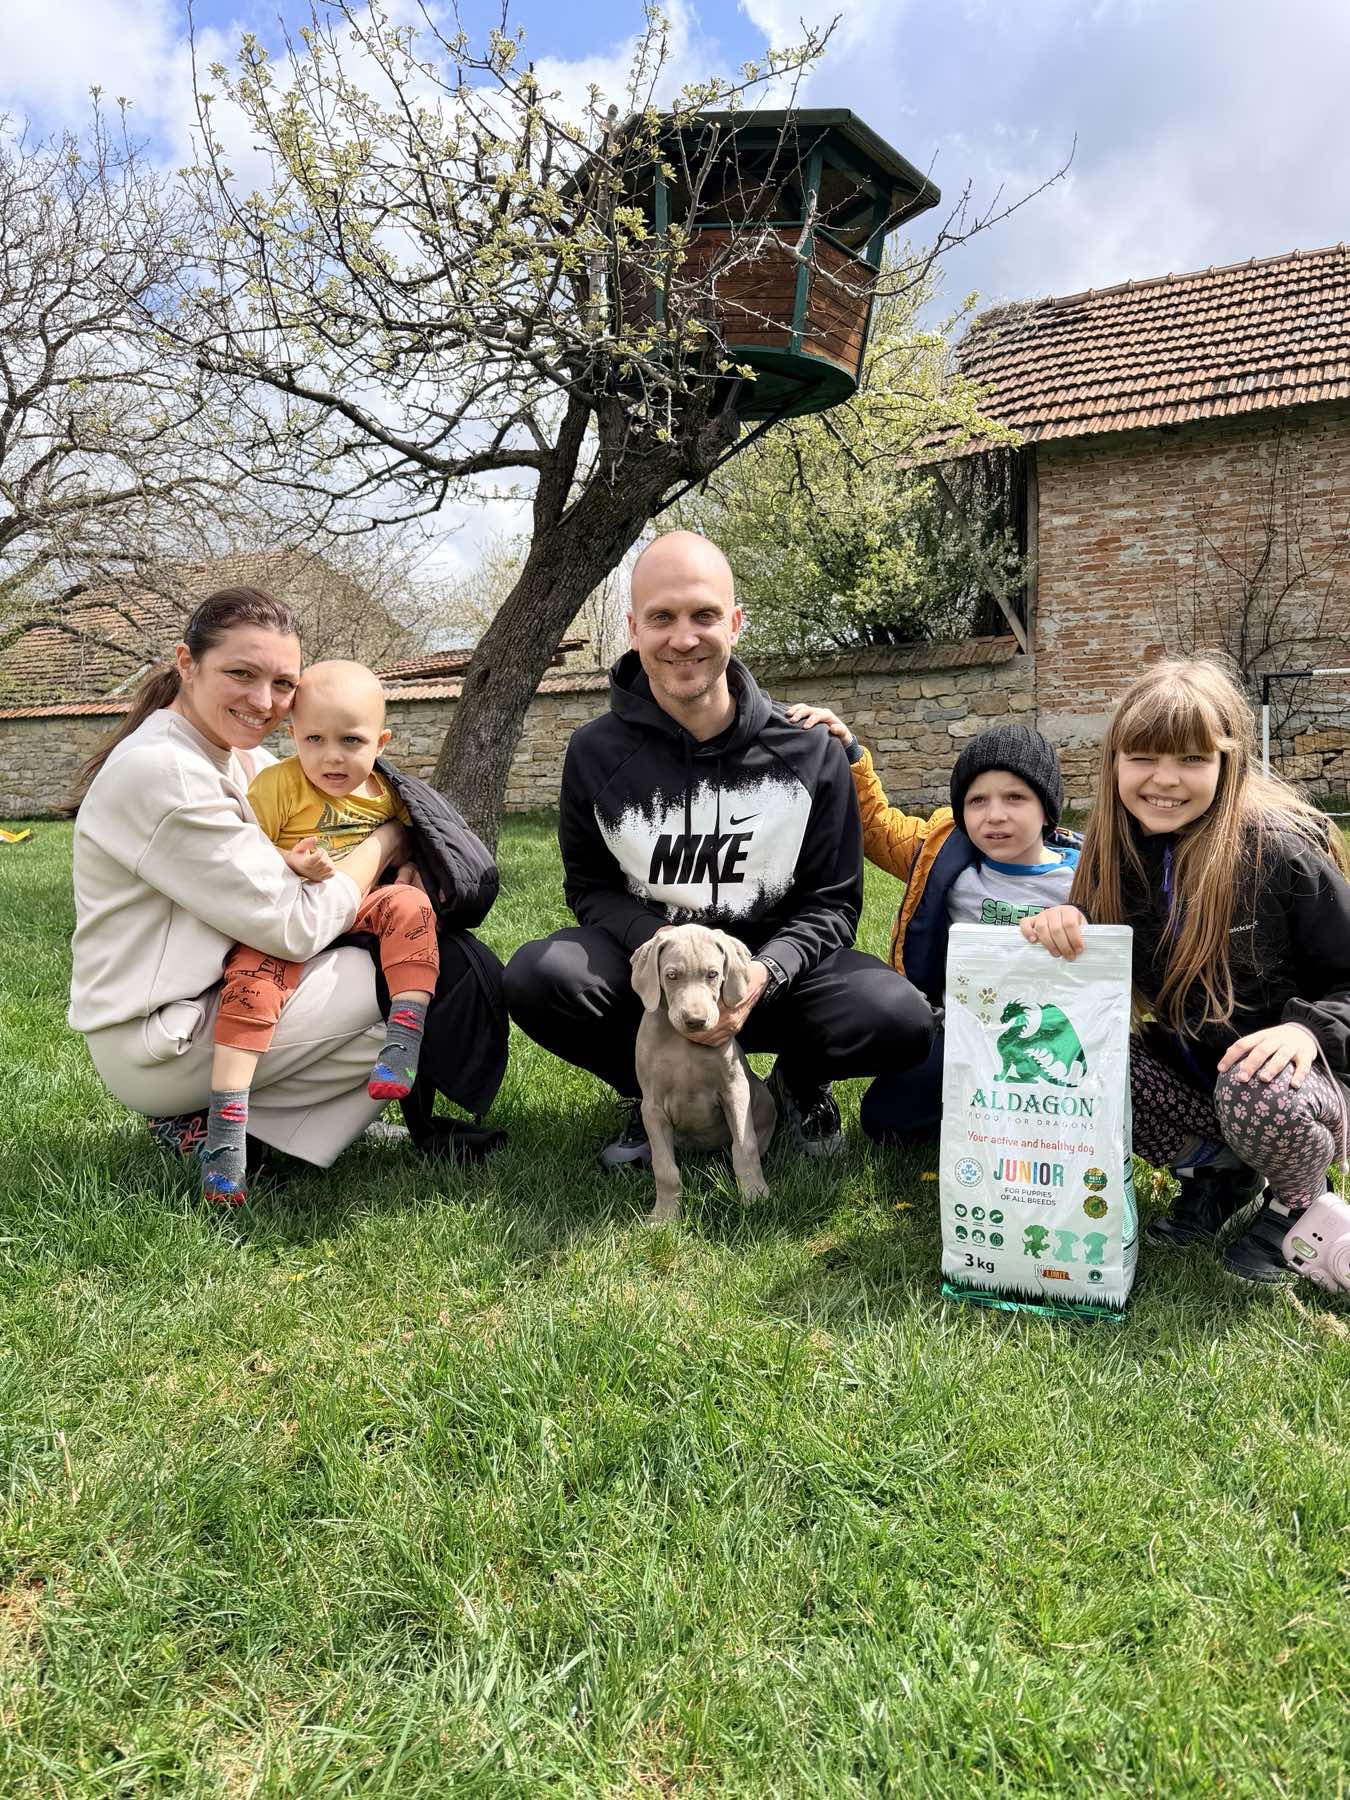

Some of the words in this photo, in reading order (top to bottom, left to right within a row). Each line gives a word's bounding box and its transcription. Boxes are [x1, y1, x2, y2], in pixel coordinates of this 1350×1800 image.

[649, 831, 754, 885] NIKE
[970, 1088, 1094, 1118] ALDAGON
[967, 1130, 987, 1142] Your
[990, 1135, 1019, 1146] active
[1021, 1138, 1038, 1149] and
[1040, 1139, 1075, 1154] healthy
[1078, 1143, 1095, 1156] dog
[993, 1158, 1064, 1187] JUNIOR
[1000, 1193, 1010, 1201] OF
[1011, 1194, 1026, 1203] ALL
[1027, 1197, 1057, 1206] BREEDS
[1004, 1186, 1020, 1194] FOR
[1021, 1188, 1052, 1198] PUPPIES
[964, 1253, 974, 1267] 3
[977, 1256, 995, 1274] kg
